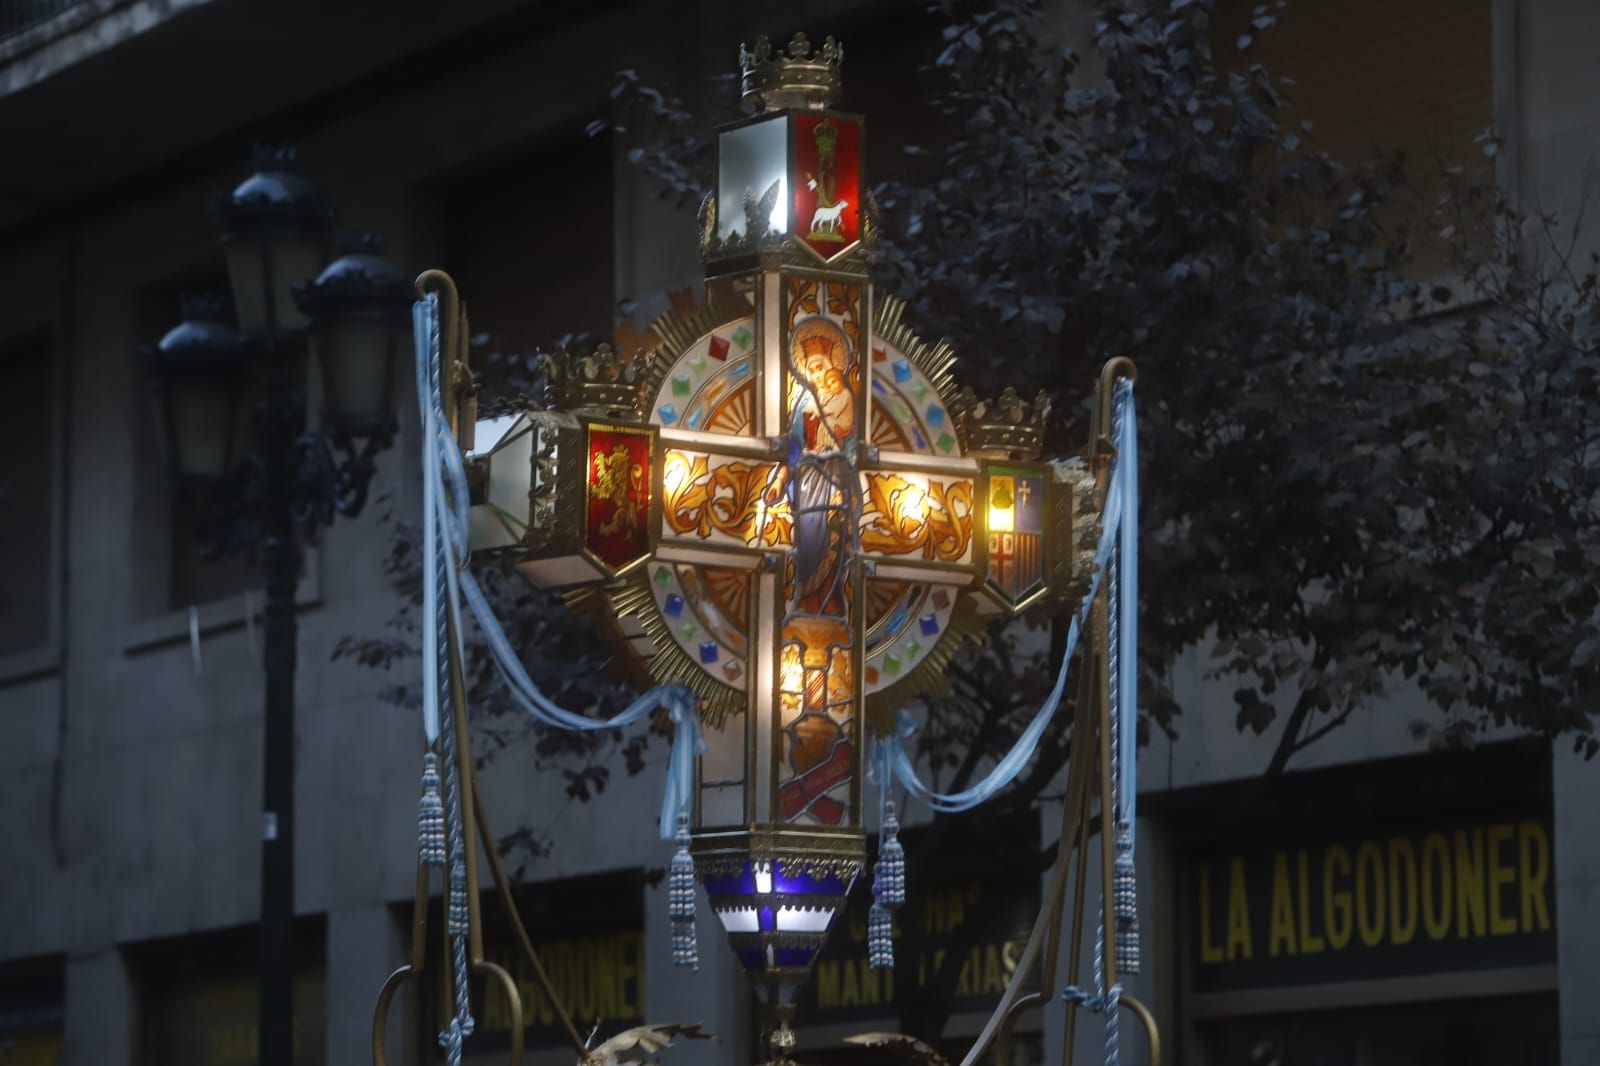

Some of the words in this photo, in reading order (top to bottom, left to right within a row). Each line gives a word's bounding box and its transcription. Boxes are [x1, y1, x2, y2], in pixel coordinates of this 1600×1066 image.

[1200, 855, 1254, 963] LA
[1269, 820, 1551, 957] ALGODONER
[482, 929, 645, 1031] AGODONE
[815, 940, 1019, 1008] MANTRIAS
